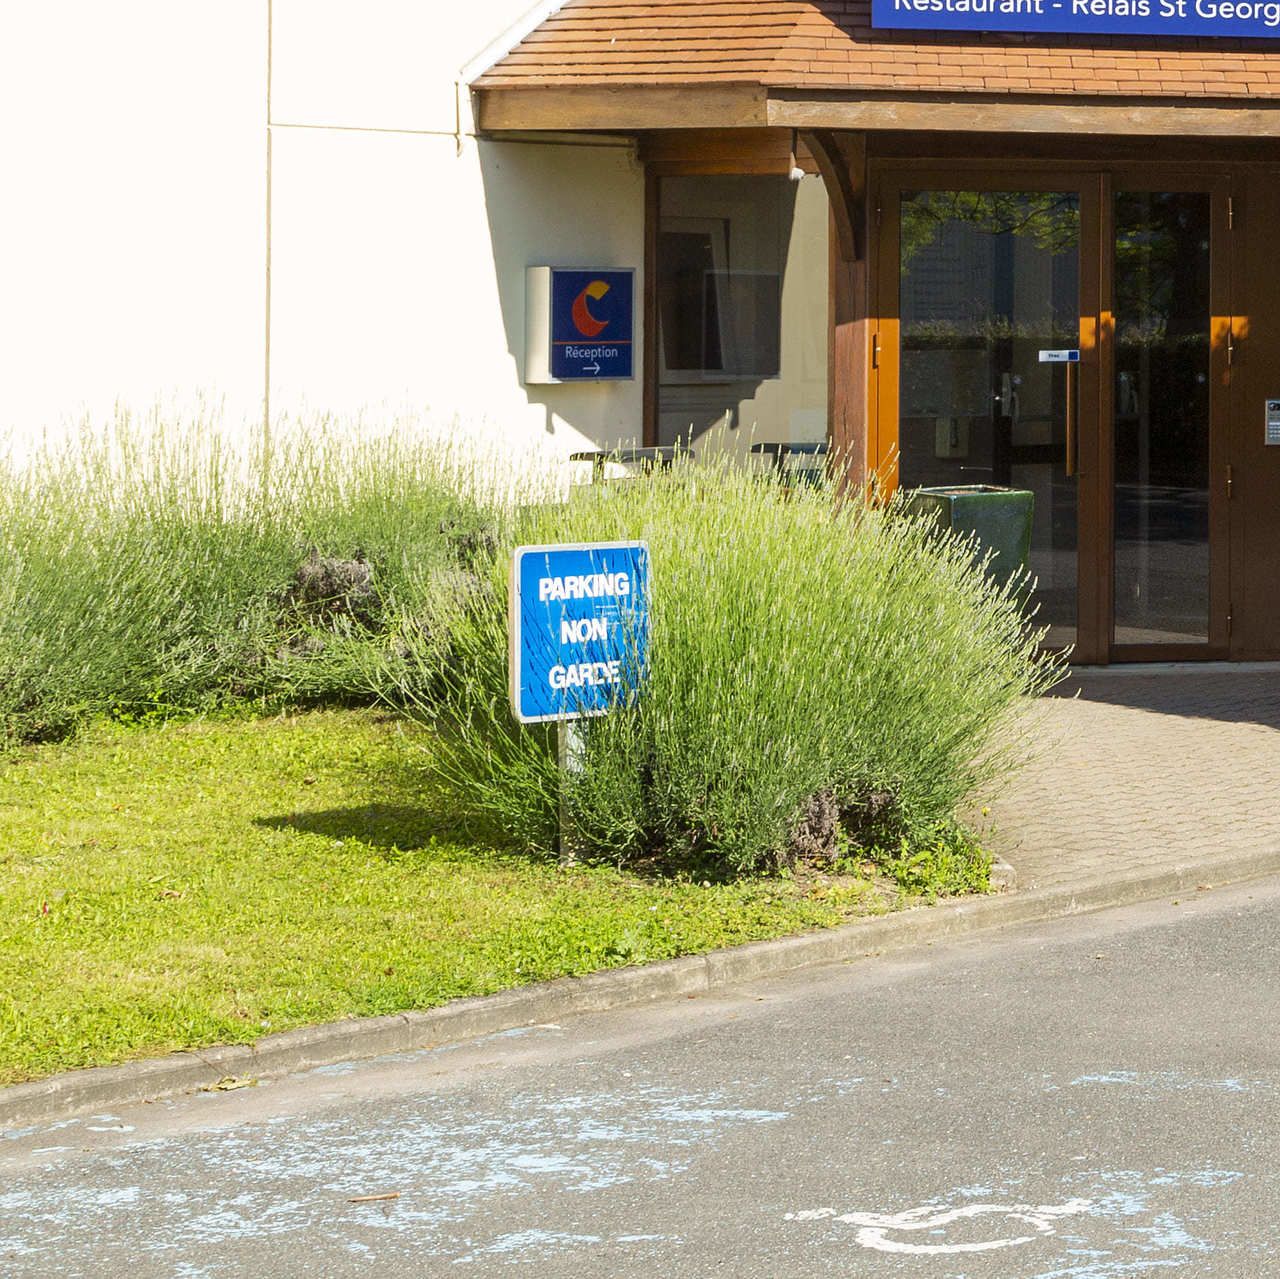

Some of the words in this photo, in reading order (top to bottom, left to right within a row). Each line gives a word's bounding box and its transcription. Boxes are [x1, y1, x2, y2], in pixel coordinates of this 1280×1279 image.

[565, 345, 618, 361] Réception
[539, 572, 630, 601] PARKING
[561, 617, 608, 644] NON
